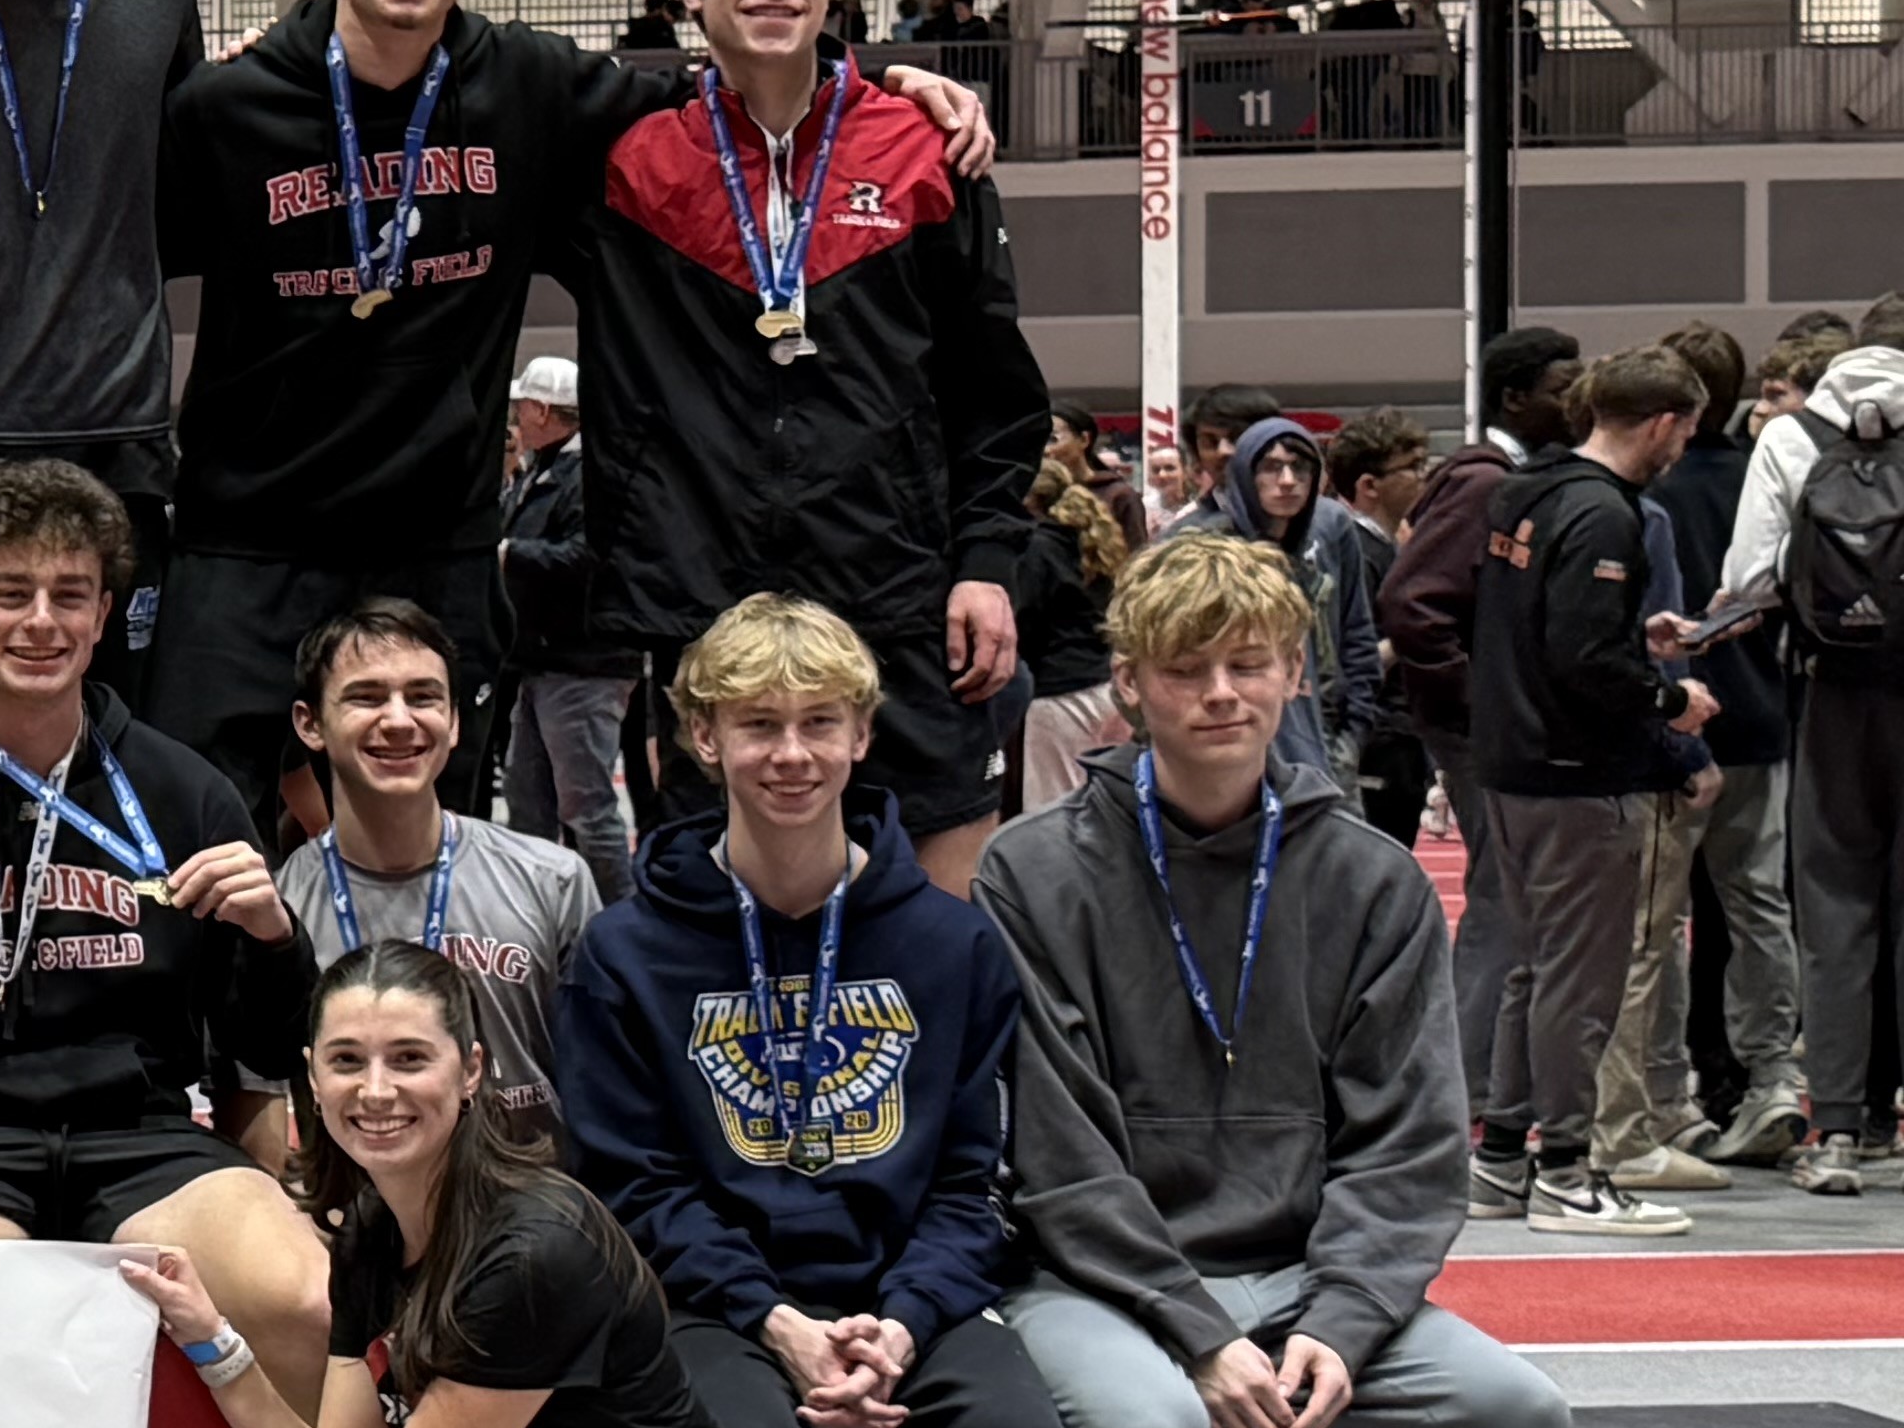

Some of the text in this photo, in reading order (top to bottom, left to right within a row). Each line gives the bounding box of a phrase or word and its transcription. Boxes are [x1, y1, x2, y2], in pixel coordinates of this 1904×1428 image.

[1239, 89, 1271, 128] 11
[1142, 73, 1180, 241] balance
[57, 933, 144, 969] FIELD
